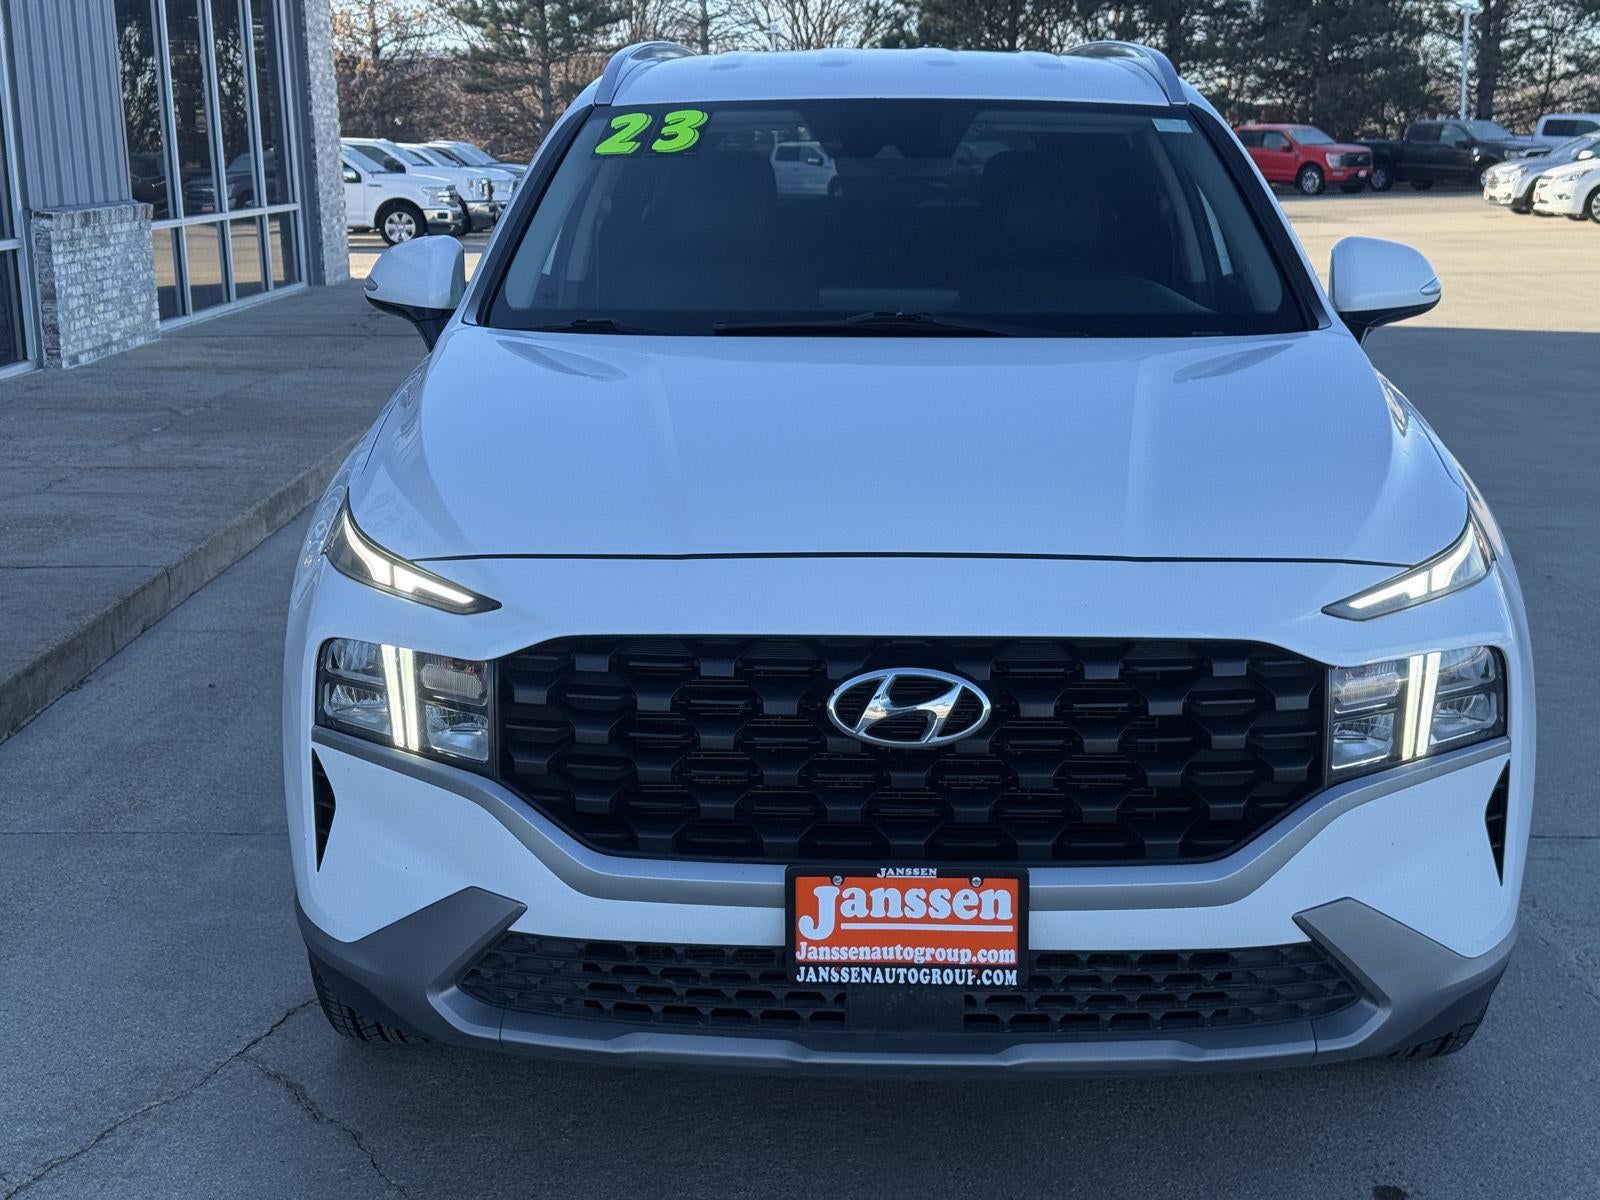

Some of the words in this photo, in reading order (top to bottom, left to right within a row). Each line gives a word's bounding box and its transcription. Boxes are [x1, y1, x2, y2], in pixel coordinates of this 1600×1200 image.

[594, 109, 709, 155] 23
[876, 867, 938, 878] JANSSEN
[798, 885, 1013, 940] Janssen
[795, 941, 1016, 964] Janssenautogroup.com
[796, 966, 1018, 986] JANSSENAUTOGROUP.COM
